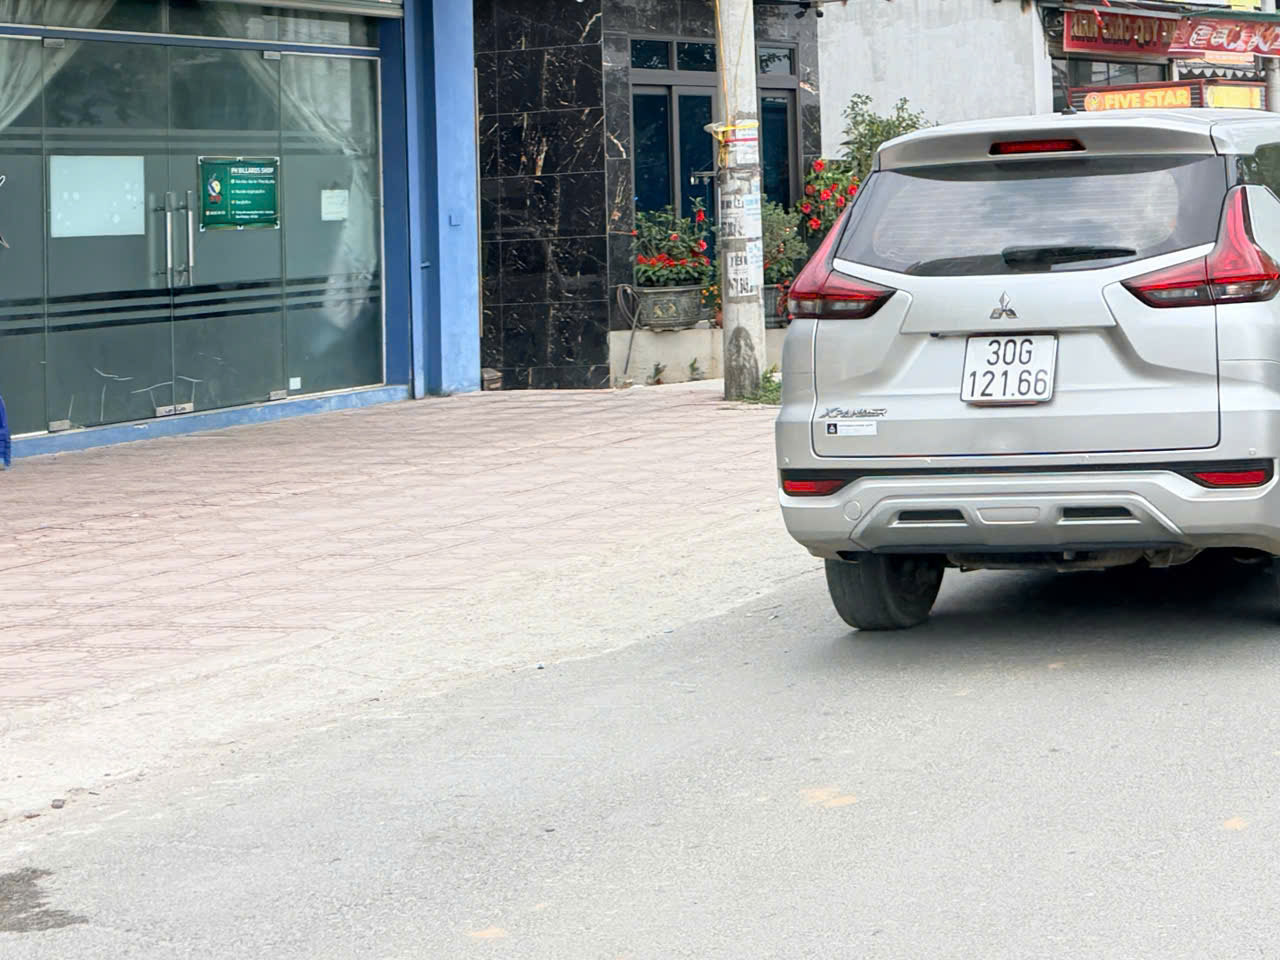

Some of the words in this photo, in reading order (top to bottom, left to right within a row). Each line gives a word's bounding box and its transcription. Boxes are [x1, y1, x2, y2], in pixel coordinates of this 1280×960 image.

[1104, 93, 1141, 109] FIVE
[1143, 90, 1189, 108] STAR
[986, 338, 1034, 366] 30G
[969, 369, 1048, 398] 121.66
